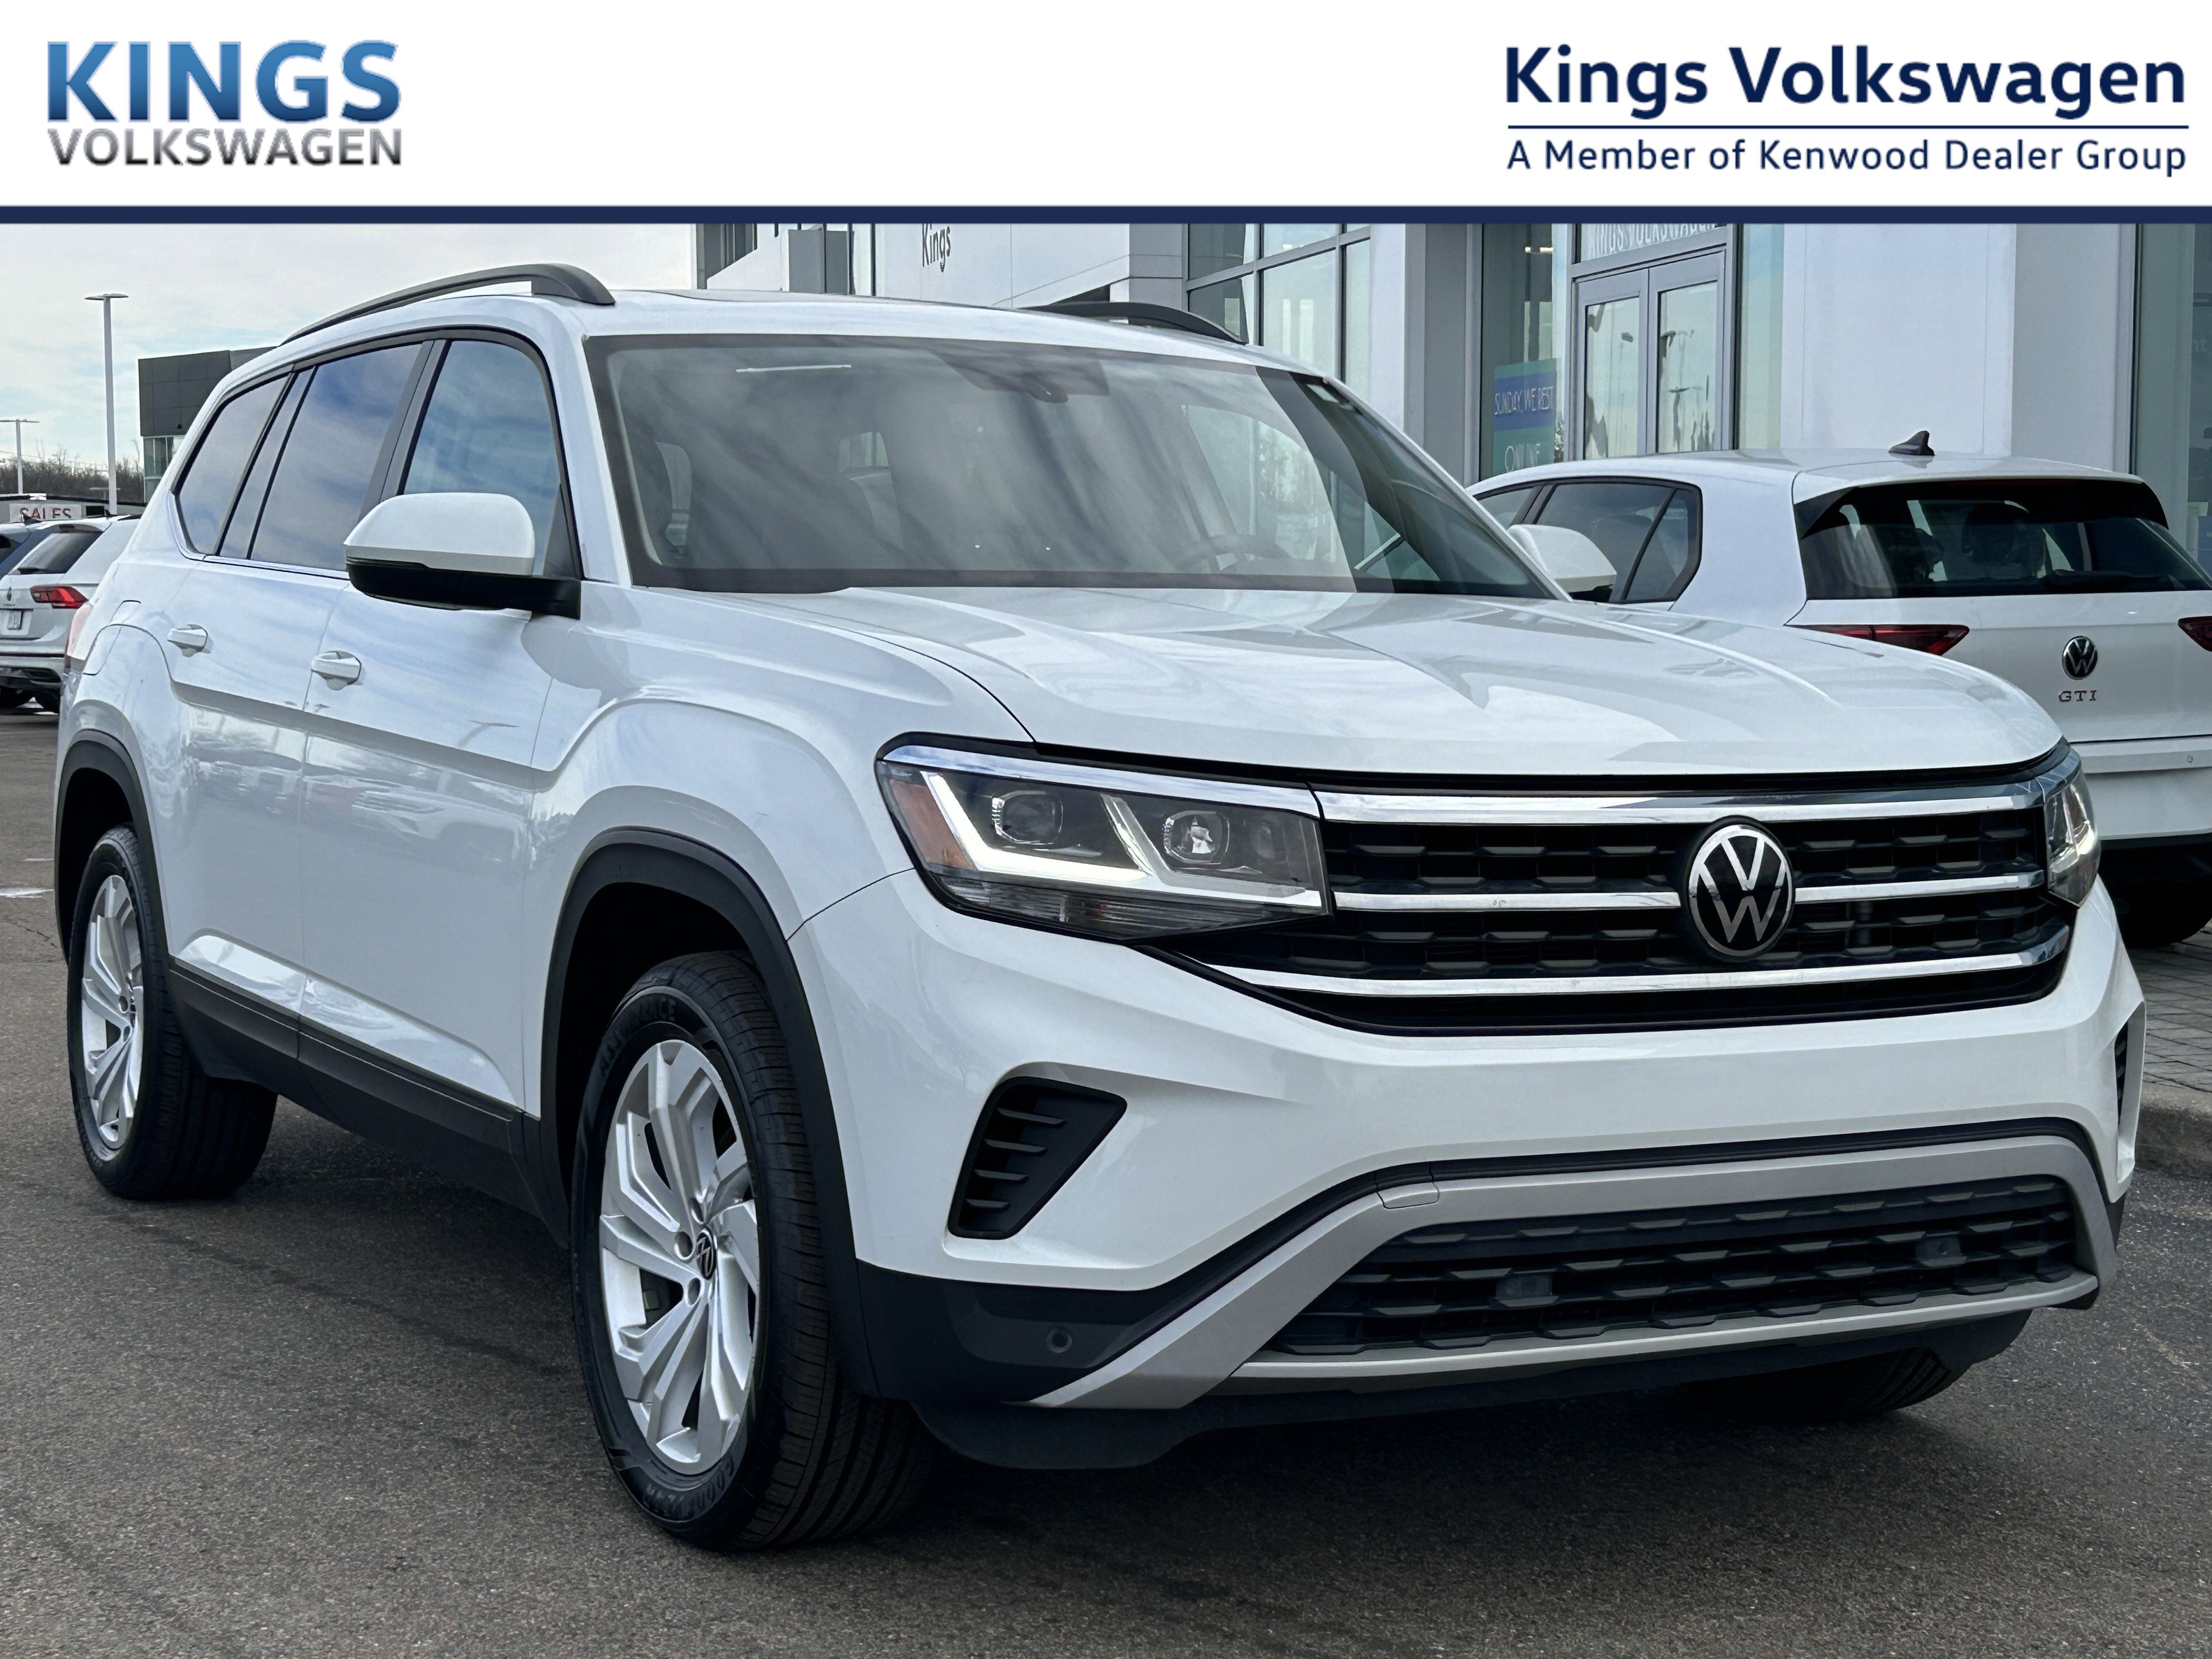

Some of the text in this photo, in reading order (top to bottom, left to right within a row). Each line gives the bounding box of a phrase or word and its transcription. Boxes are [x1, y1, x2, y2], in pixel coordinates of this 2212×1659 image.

[922, 223, 951, 273] Kings
[1628, 224, 1717, 246] VOLKSWA
[2058, 690, 2097, 702] GTI
[1689, 825, 1792, 956] VW
